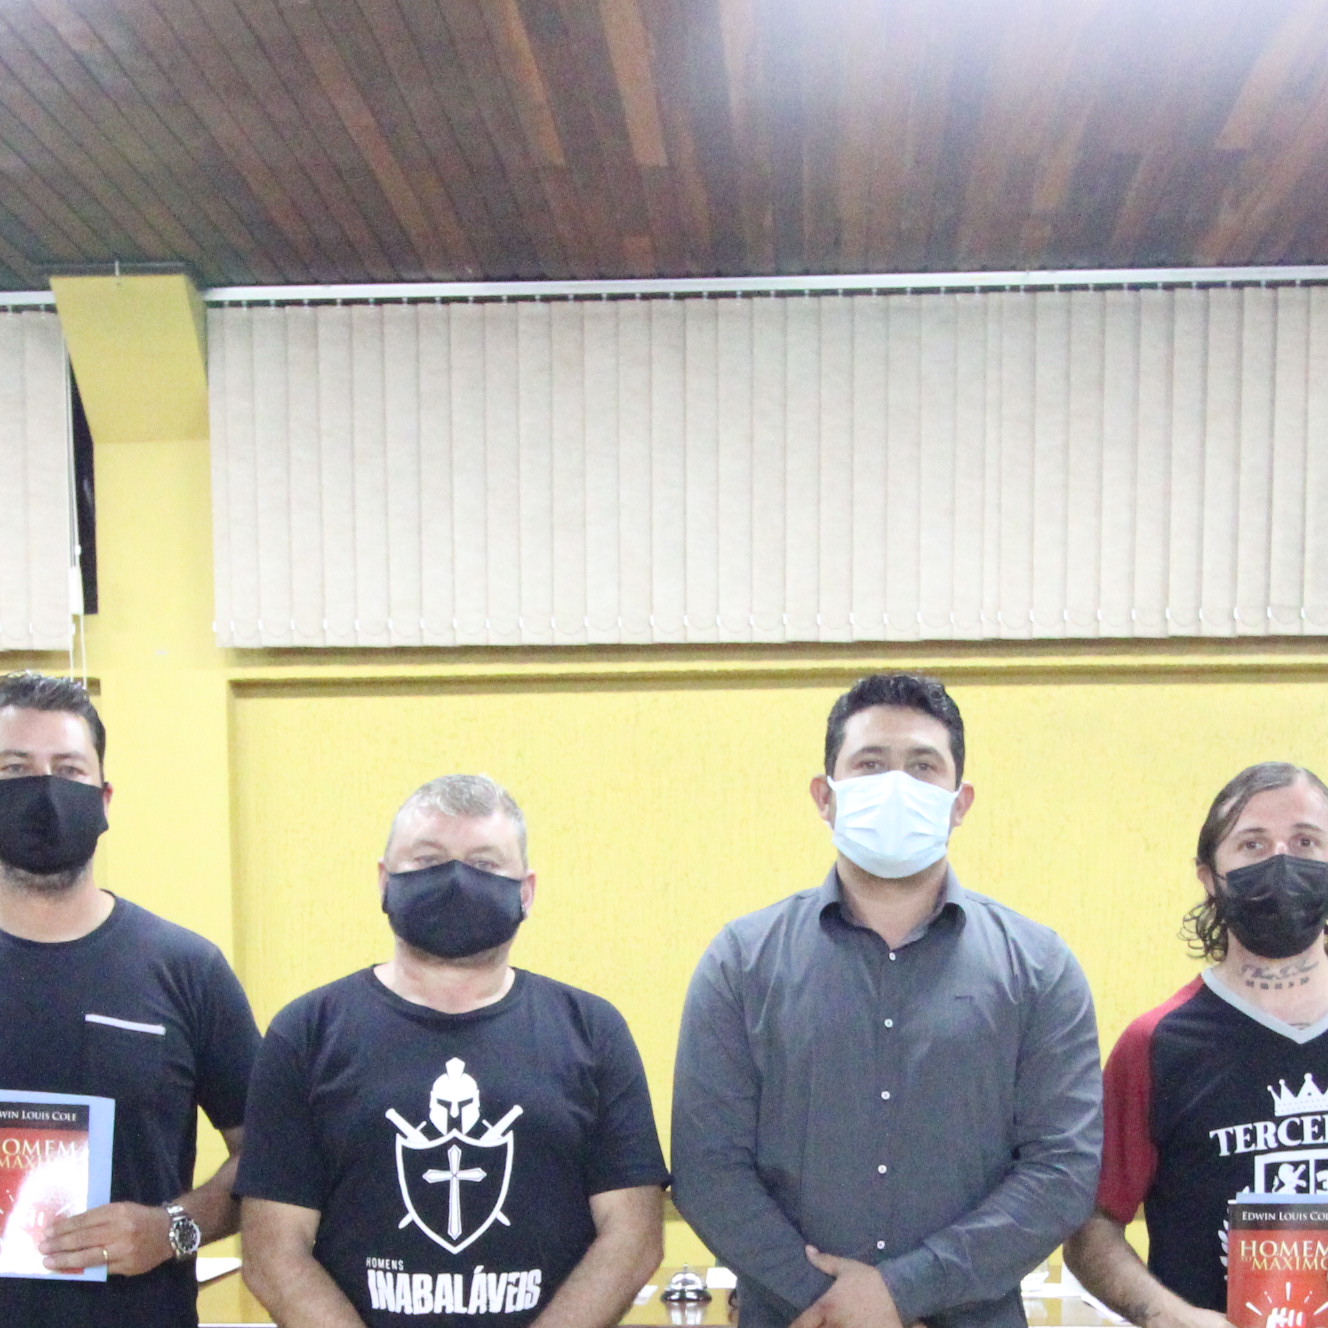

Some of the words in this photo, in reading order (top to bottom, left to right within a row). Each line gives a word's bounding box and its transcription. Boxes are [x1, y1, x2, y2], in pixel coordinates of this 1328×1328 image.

[21, 1109, 50, 1120] LOUIS
[52, 1111, 77, 1121] COLE
[1242, 1211, 1276, 1221] EDWIN
[1279, 1211, 1308, 1221] LOUIS
[365, 1256, 405, 1271] HOMENS
[367, 1265, 543, 1316] INABALÁVEIS
